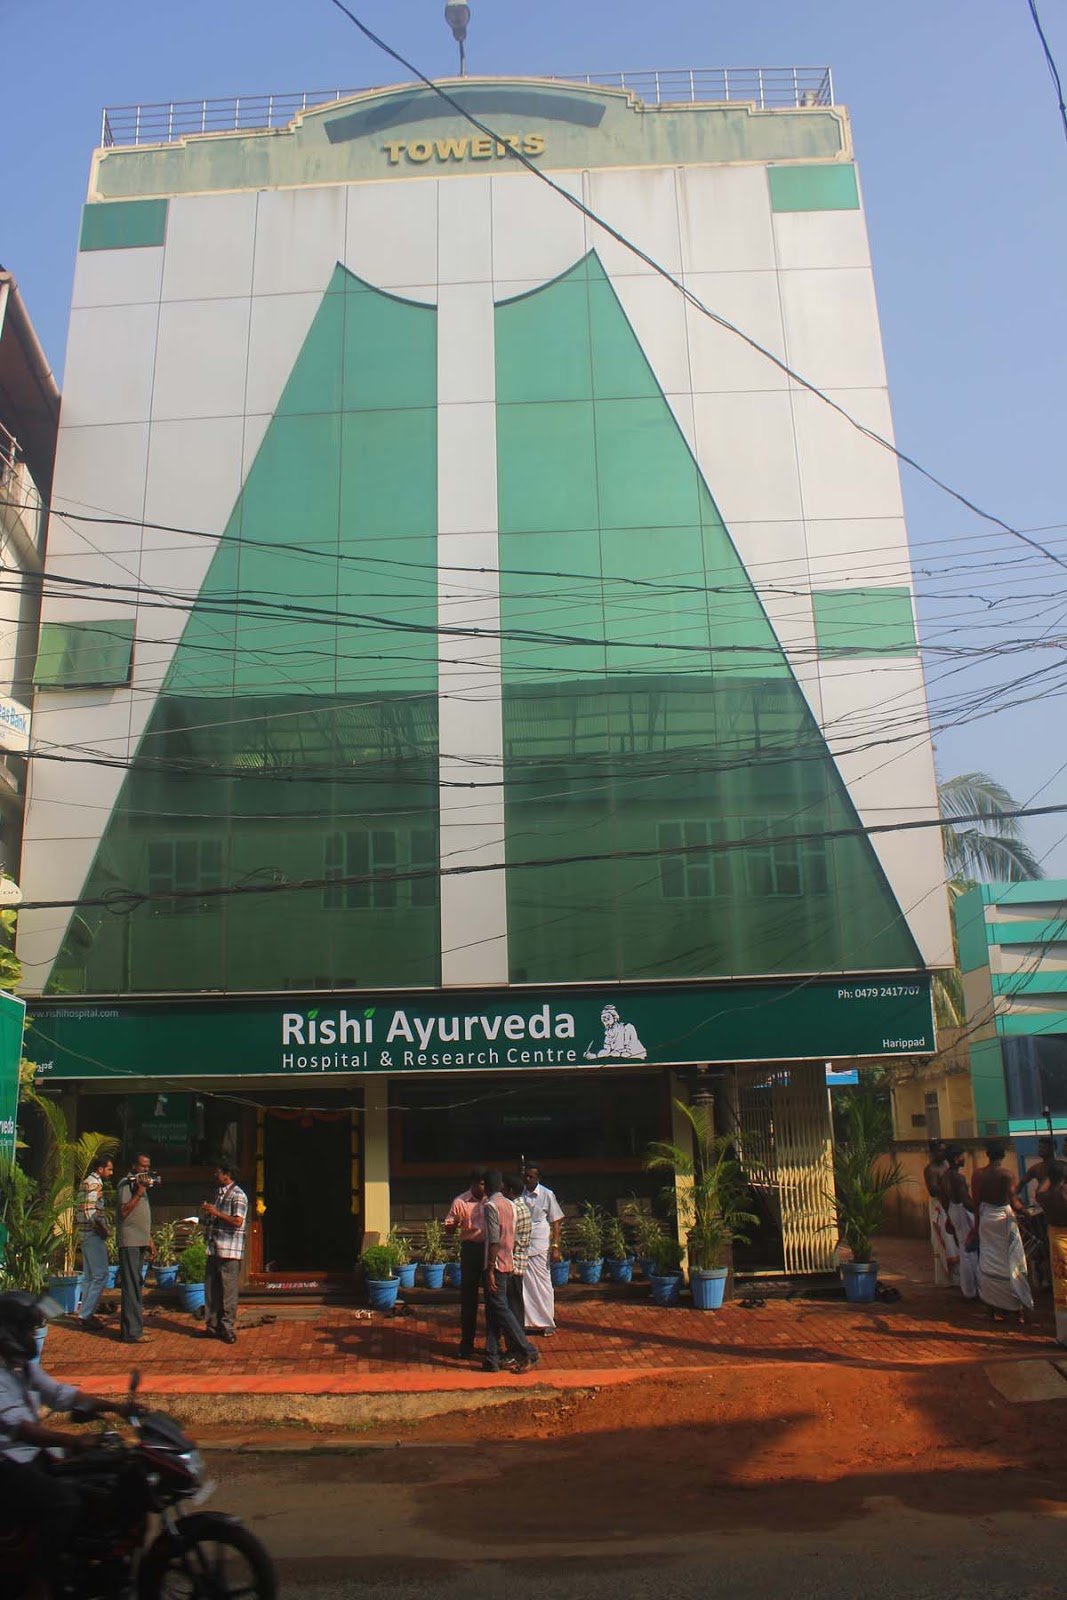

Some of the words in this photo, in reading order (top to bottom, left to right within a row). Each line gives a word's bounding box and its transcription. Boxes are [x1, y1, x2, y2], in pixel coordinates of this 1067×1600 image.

[382, 132, 547, 164] TOWERS
[838, 989, 853, 999] Ph:
[854, 988, 878, 998] 0479
[880, 986, 920, 997] 2417707
[282, 1007, 376, 1045] Rishi
[386, 1004, 576, 1051] Ayurveda
[882, 1036, 926, 1049] Harippad
[283, 1051, 367, 1071] Hospital
[380, 1051, 393, 1067] &
[404, 1048, 499, 1066] Research
[507, 1048, 577, 1063] Centre
